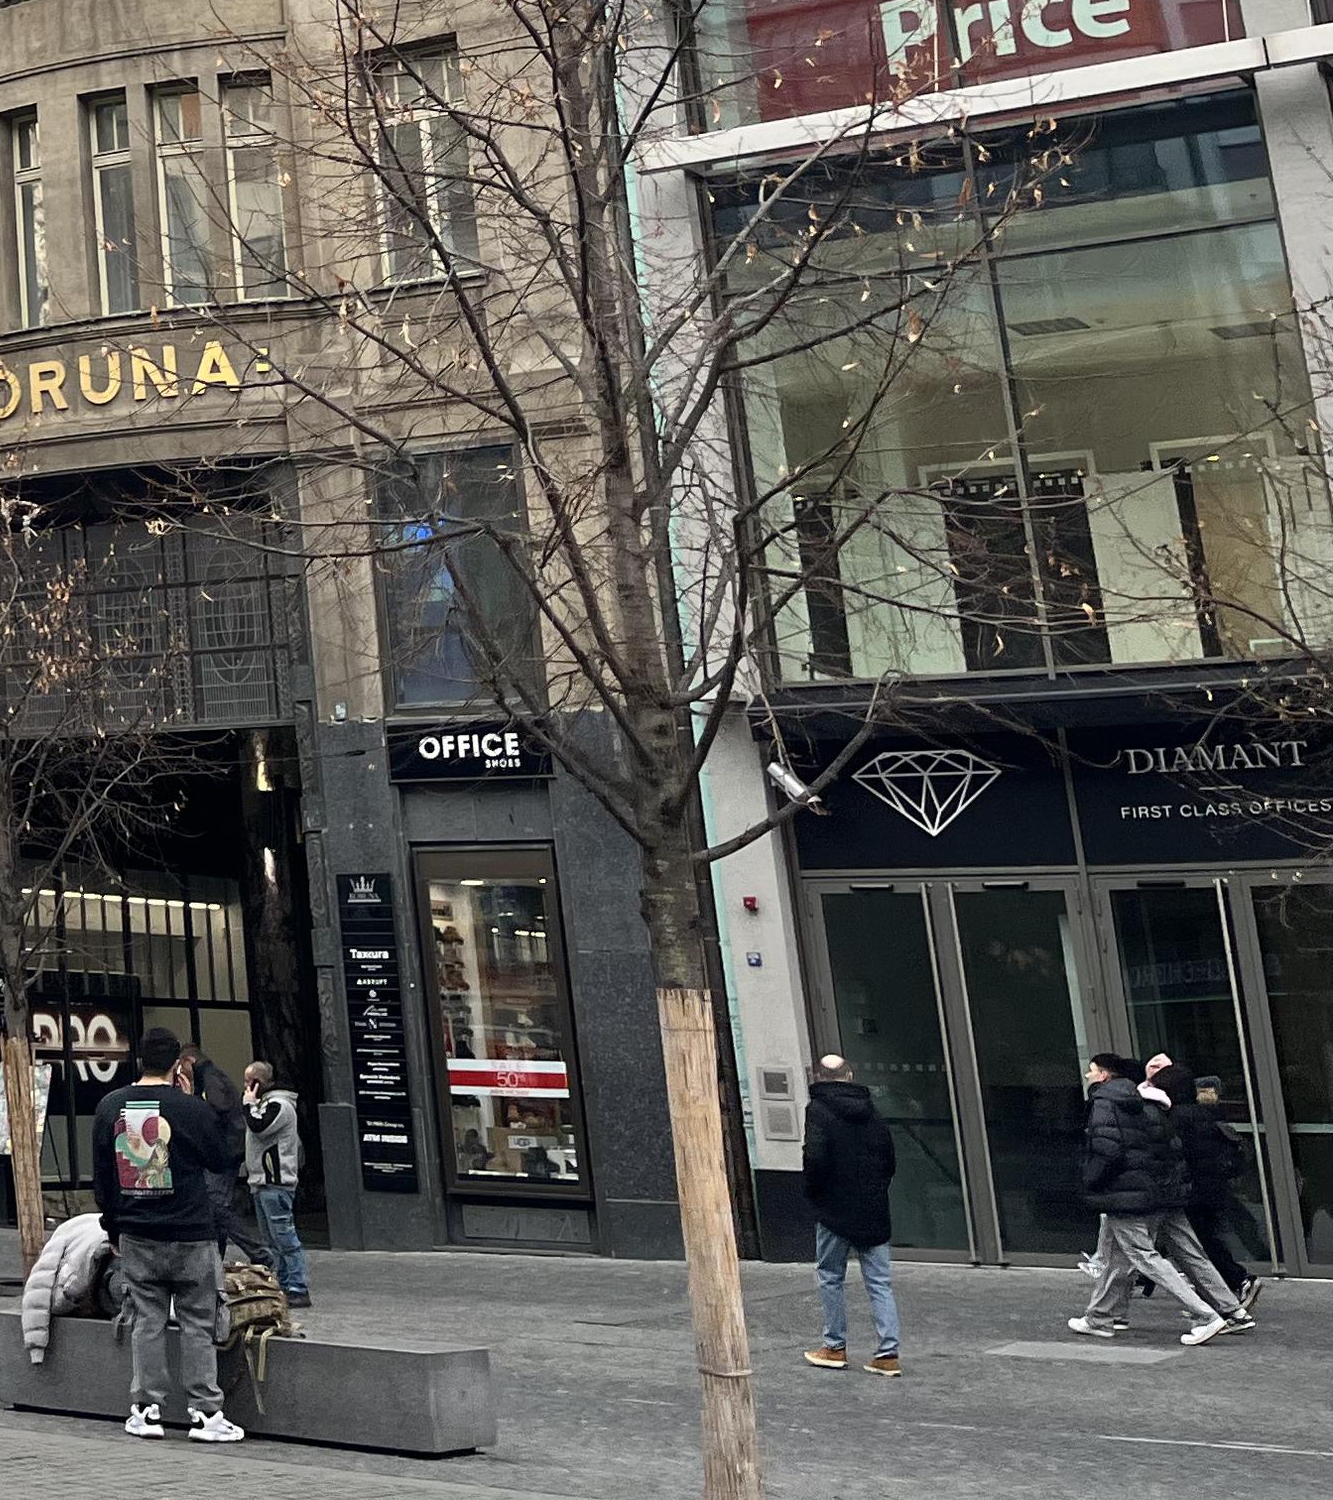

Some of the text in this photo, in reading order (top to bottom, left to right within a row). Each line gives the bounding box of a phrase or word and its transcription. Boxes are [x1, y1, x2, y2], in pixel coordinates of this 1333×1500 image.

[418, 733, 520, 760] OFFICE
[1123, 740, 1308, 775] DIAMANT
[484, 758, 521, 769] SHOES
[1120, 798, 1333, 819] FIRST CLASS OFFICES
